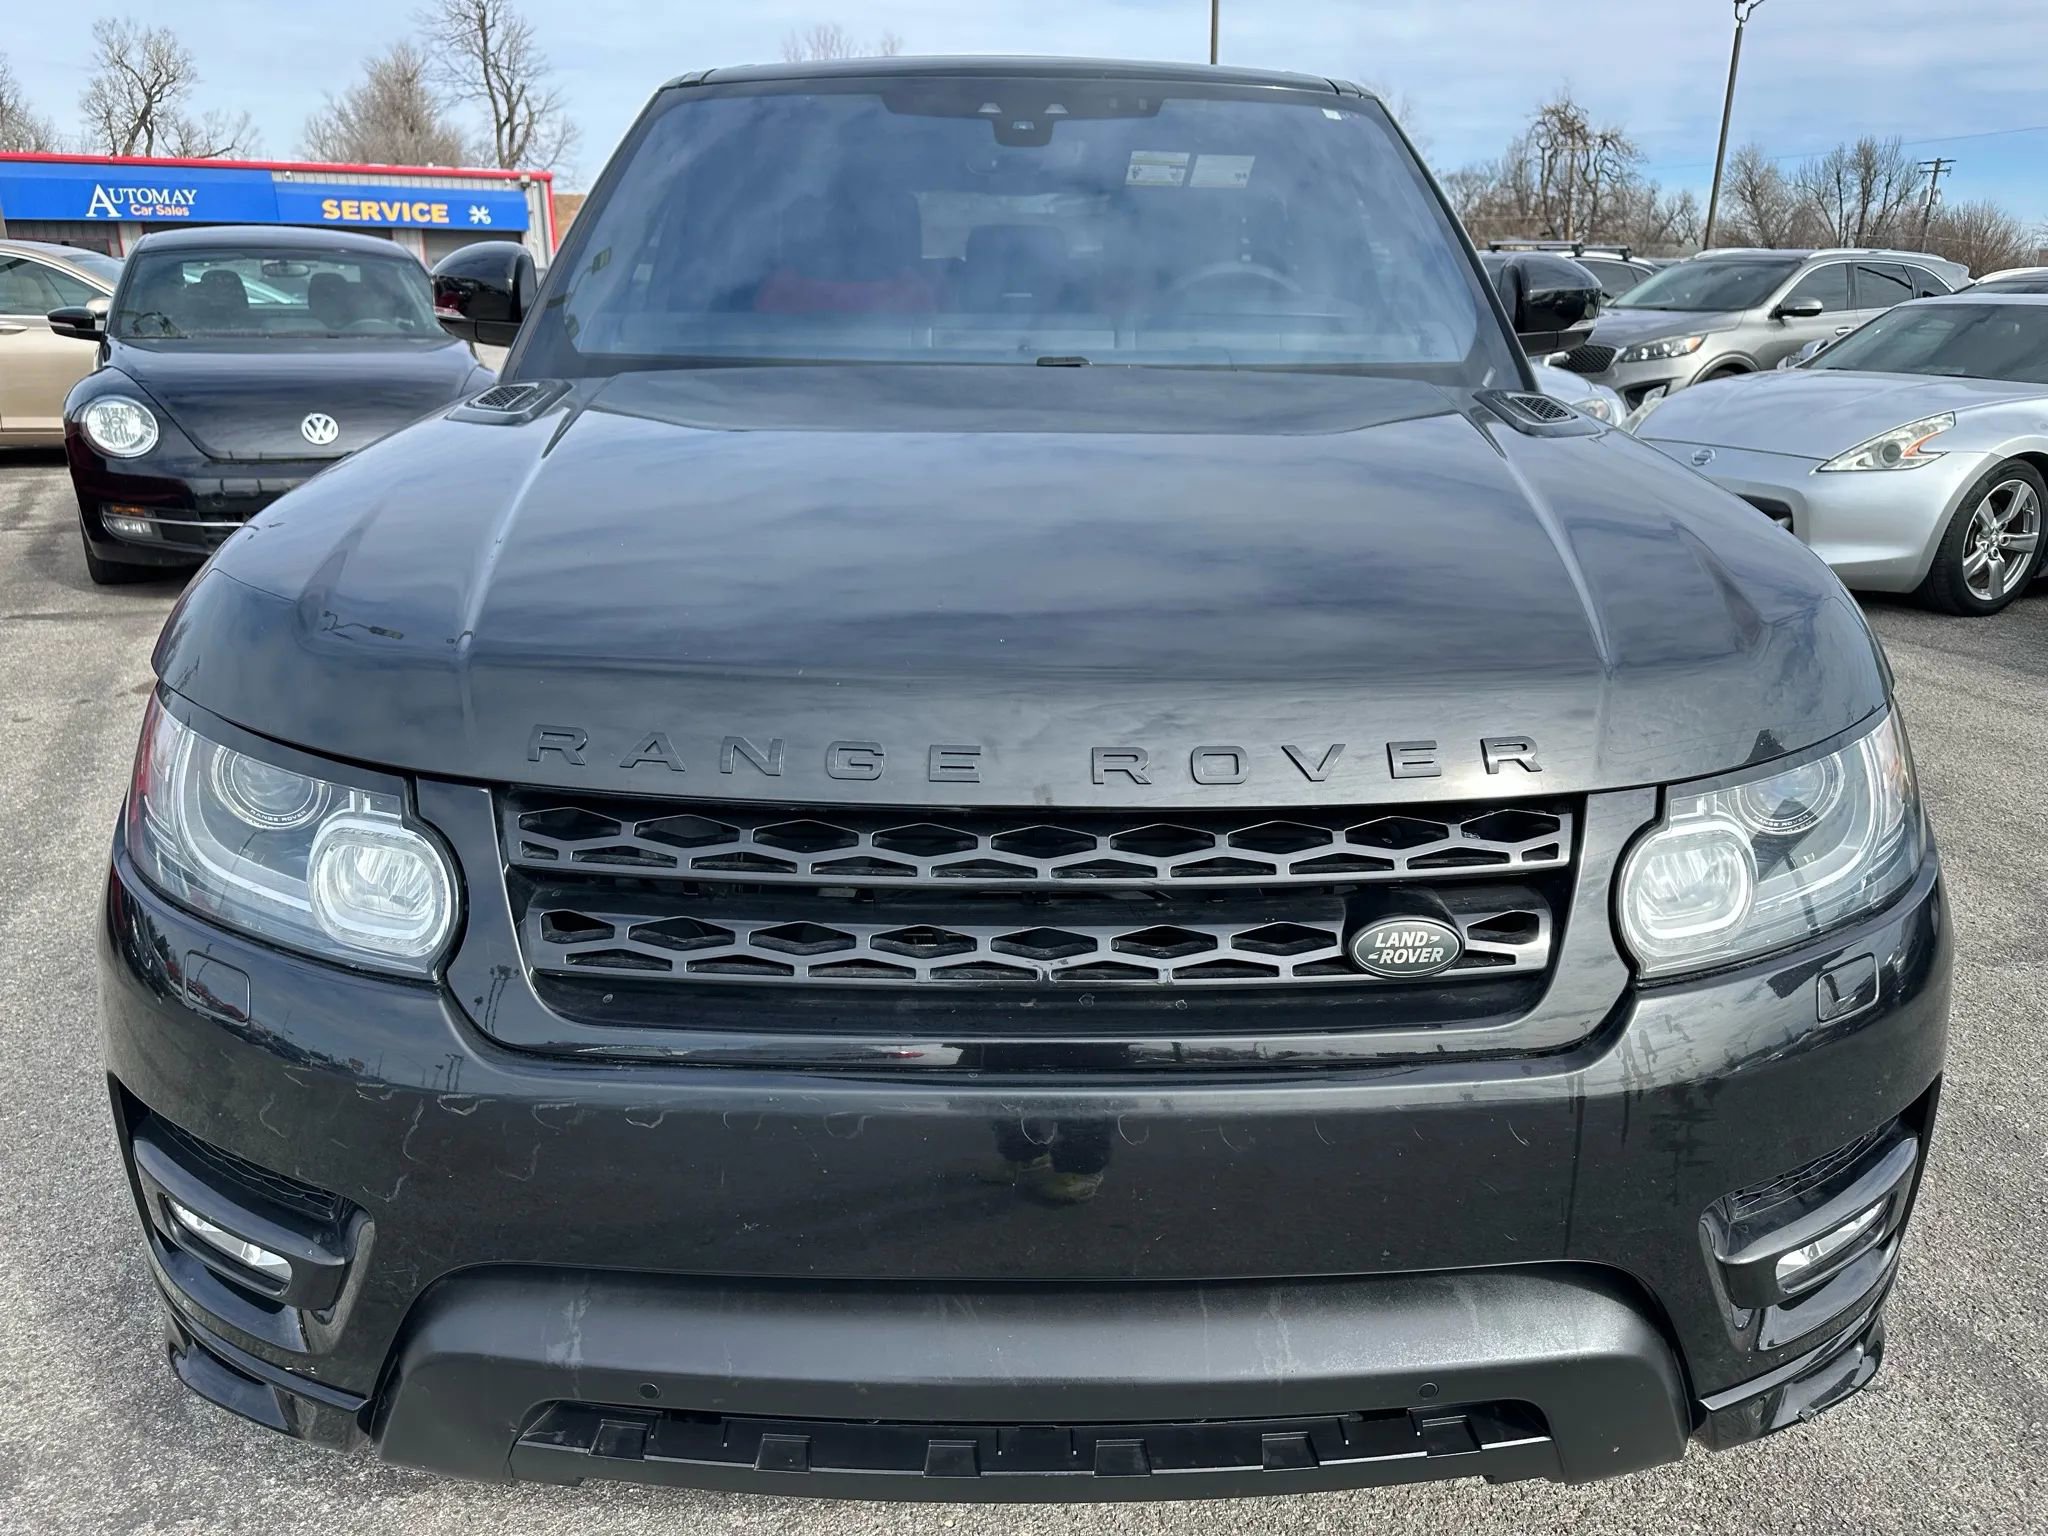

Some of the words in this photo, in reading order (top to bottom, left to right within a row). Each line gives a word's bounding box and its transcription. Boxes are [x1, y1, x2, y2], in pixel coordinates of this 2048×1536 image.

[85, 183, 198, 217] AUTOMAY
[130, 204, 153, 216] Car
[155, 204, 190, 217] Sales
[321, 198, 450, 224] SERVICE
[301, 413, 339, 445] VW
[527, 723, 982, 783] RANGE
[1091, 735, 1544, 785] ROVER
